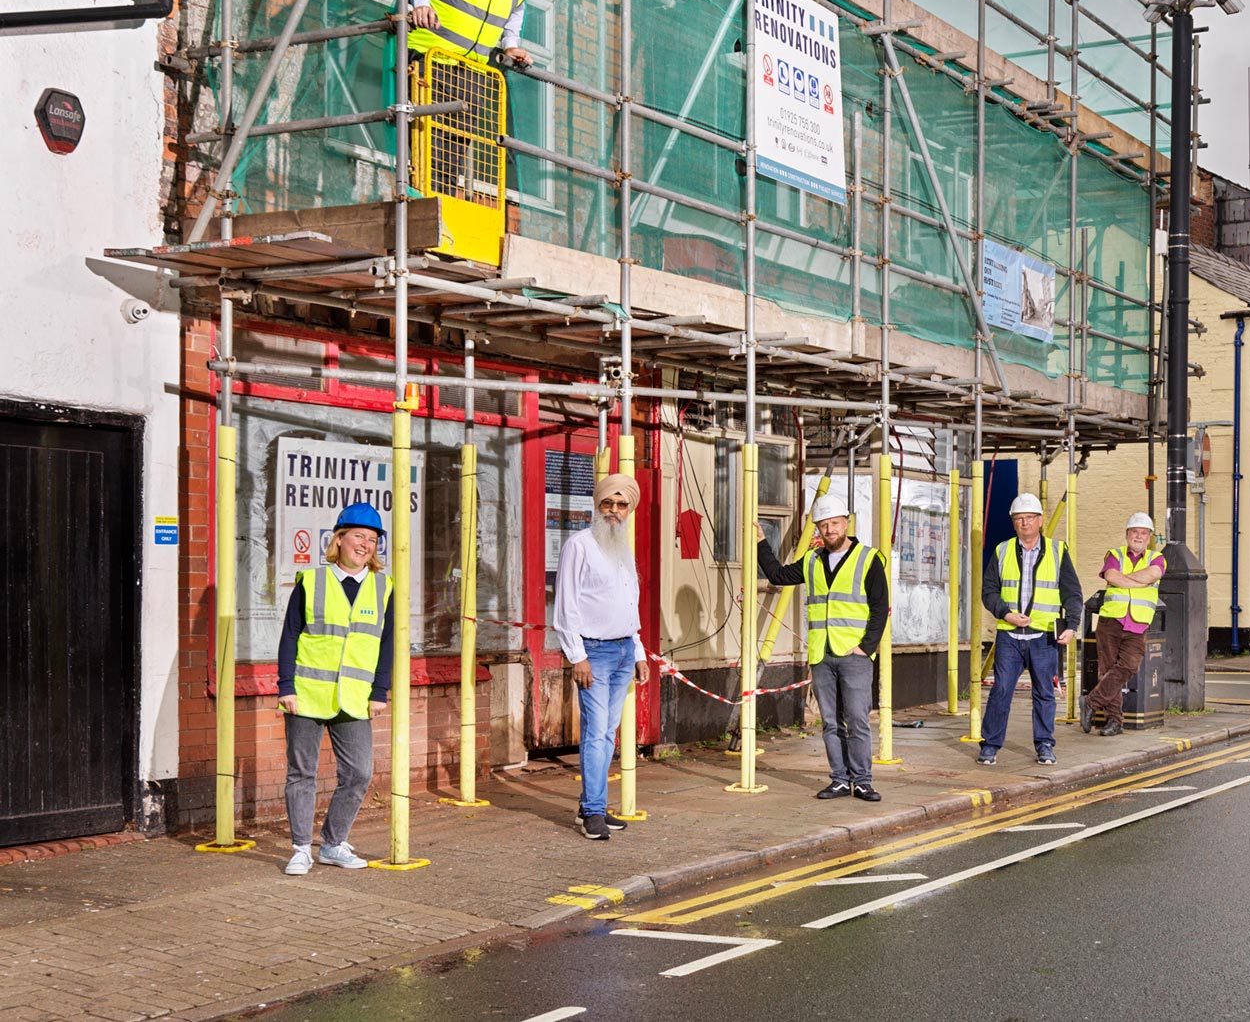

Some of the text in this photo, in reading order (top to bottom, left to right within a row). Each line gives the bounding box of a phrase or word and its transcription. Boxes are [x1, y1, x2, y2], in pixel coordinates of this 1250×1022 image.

[755, 9, 837, 69] RENOVATIONS
[287, 453, 371, 482] TRINITY
[286, 483, 419, 513] RENOVATIOS
